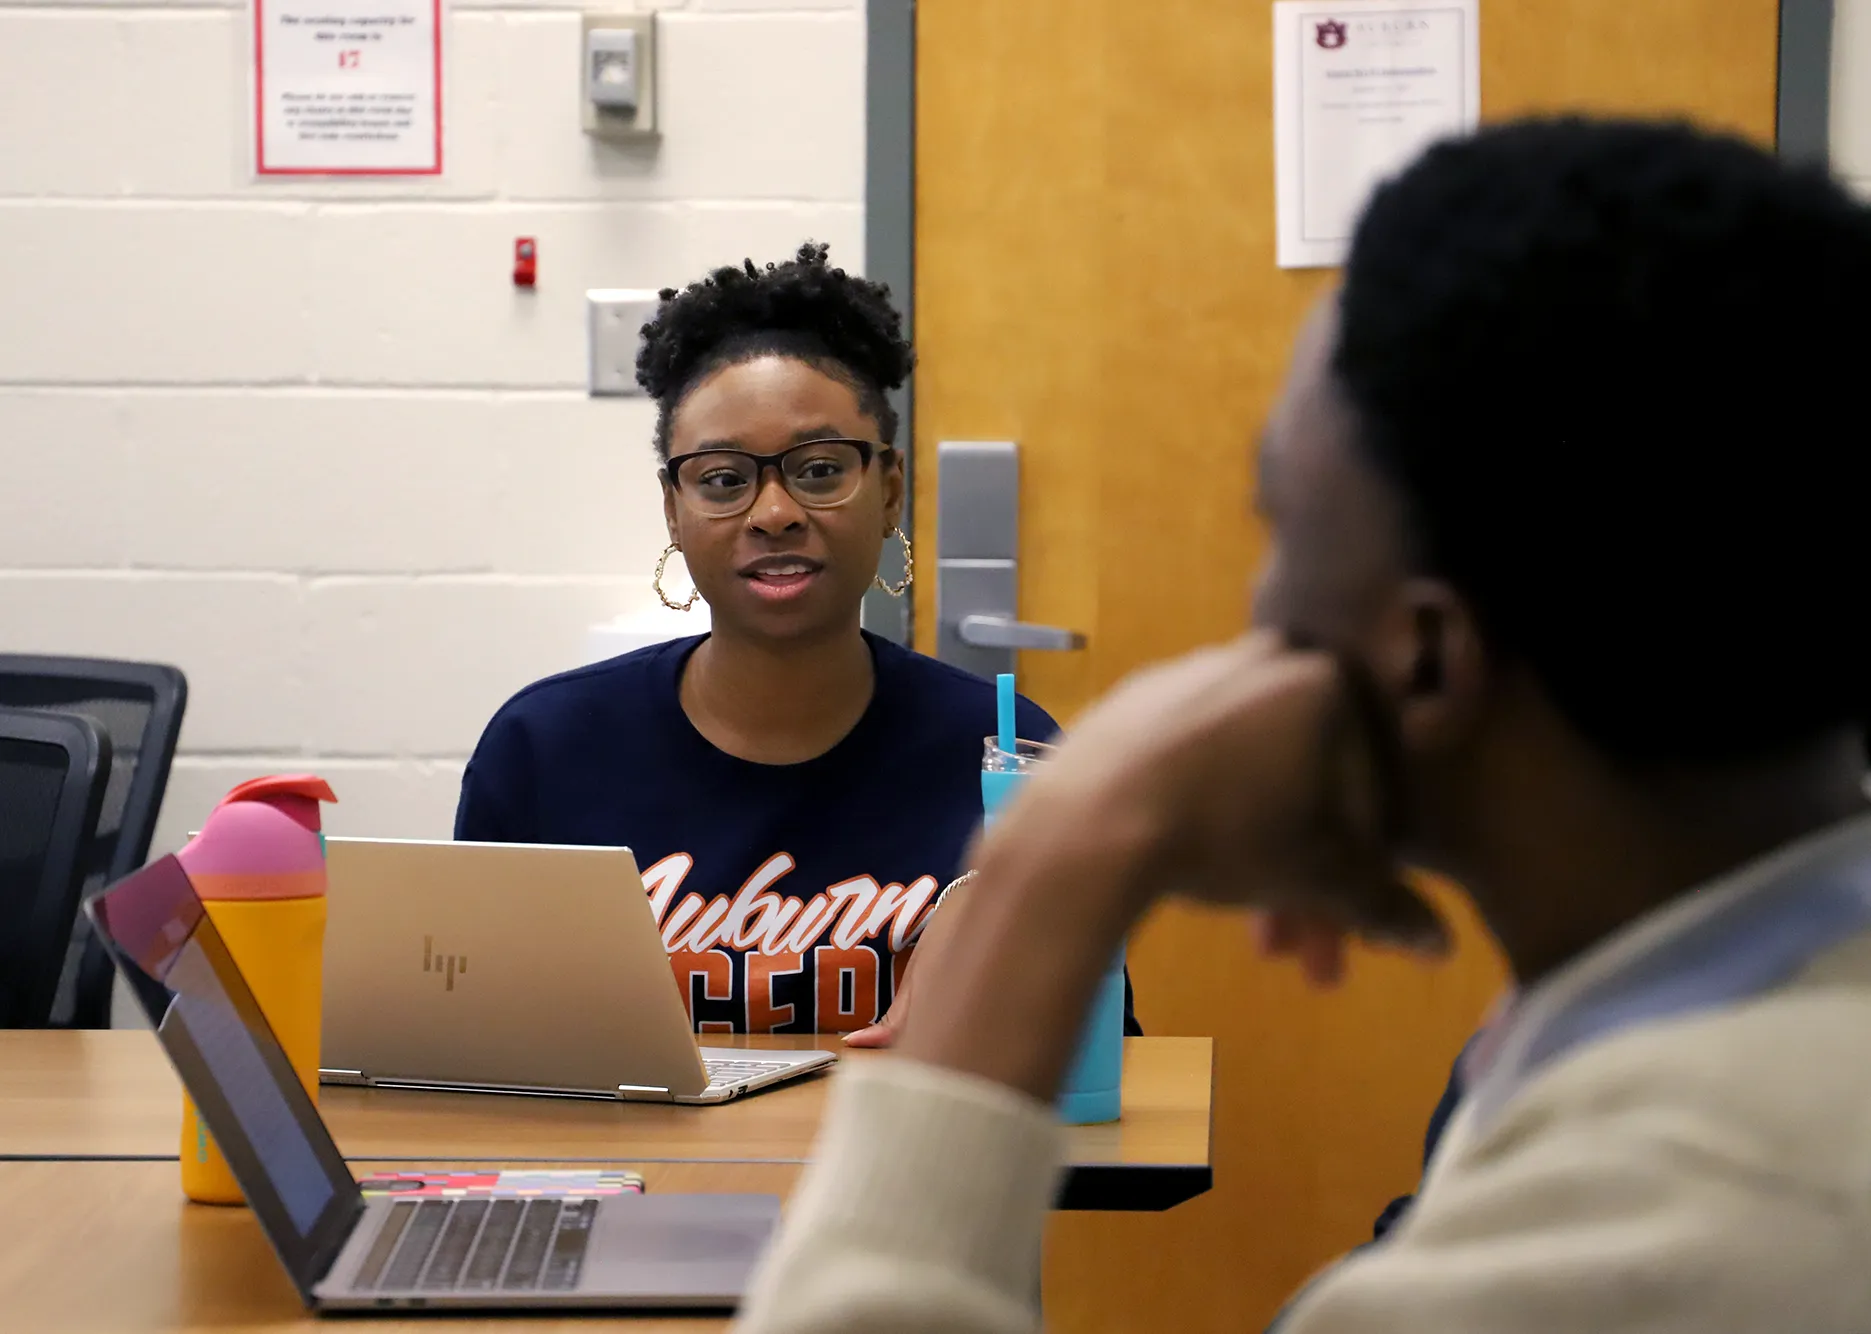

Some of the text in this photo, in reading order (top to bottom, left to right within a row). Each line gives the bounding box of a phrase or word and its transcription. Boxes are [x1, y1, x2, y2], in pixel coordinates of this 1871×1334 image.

[338, 50, 361, 68] 17
[641, 851, 937, 956] Auburn
[423, 935, 467, 991] hp
